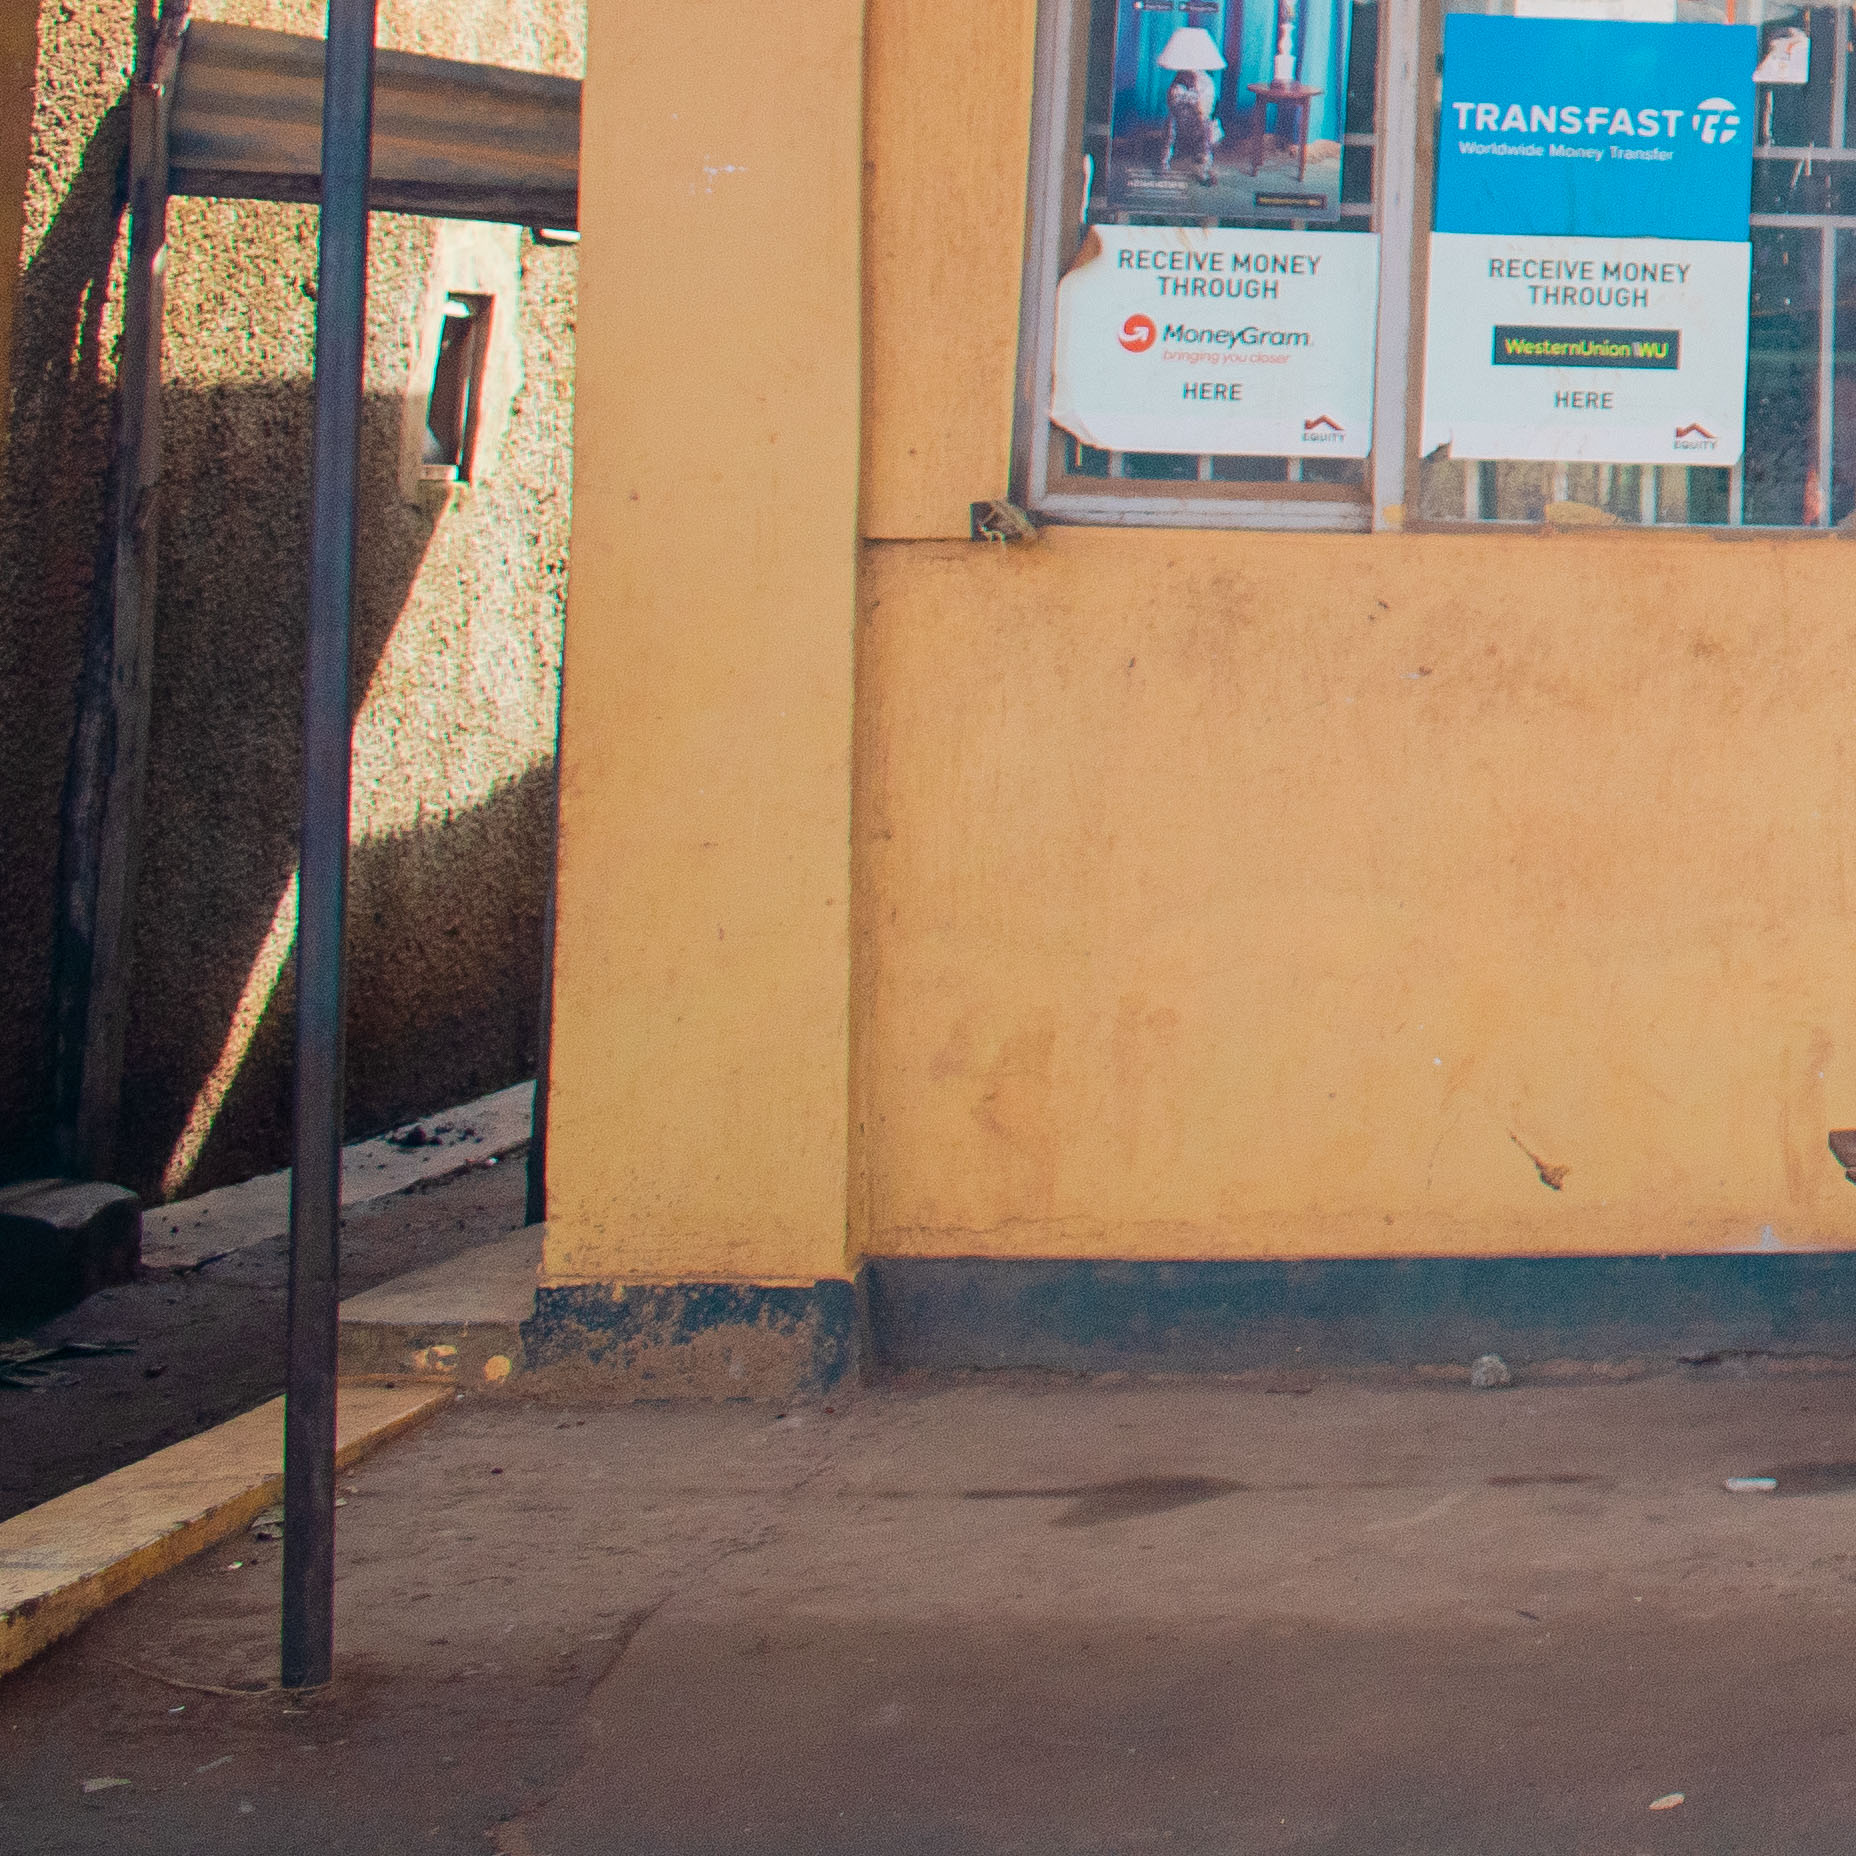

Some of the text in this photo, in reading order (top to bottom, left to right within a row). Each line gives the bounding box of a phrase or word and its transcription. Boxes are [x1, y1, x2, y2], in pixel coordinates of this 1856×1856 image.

[1452, 101, 1685, 139] TRANSFAST
[1458, 140, 1674, 162] Worldwide Money Transfer
[1118, 249, 1322, 277] RECEIVE MONEY
[1489, 258, 1692, 284] RECEIVE MONEY
[1158, 275, 1281, 300] THROUGH
[1529, 284, 1650, 308] THROUGH
[1162, 323, 1311, 350] MoneyGram
[1162, 349, 1220, 366] bringing
[1222, 351, 1248, 366] you
[1183, 382, 1244, 401] HERE
[1554, 391, 1615, 410] HERE
